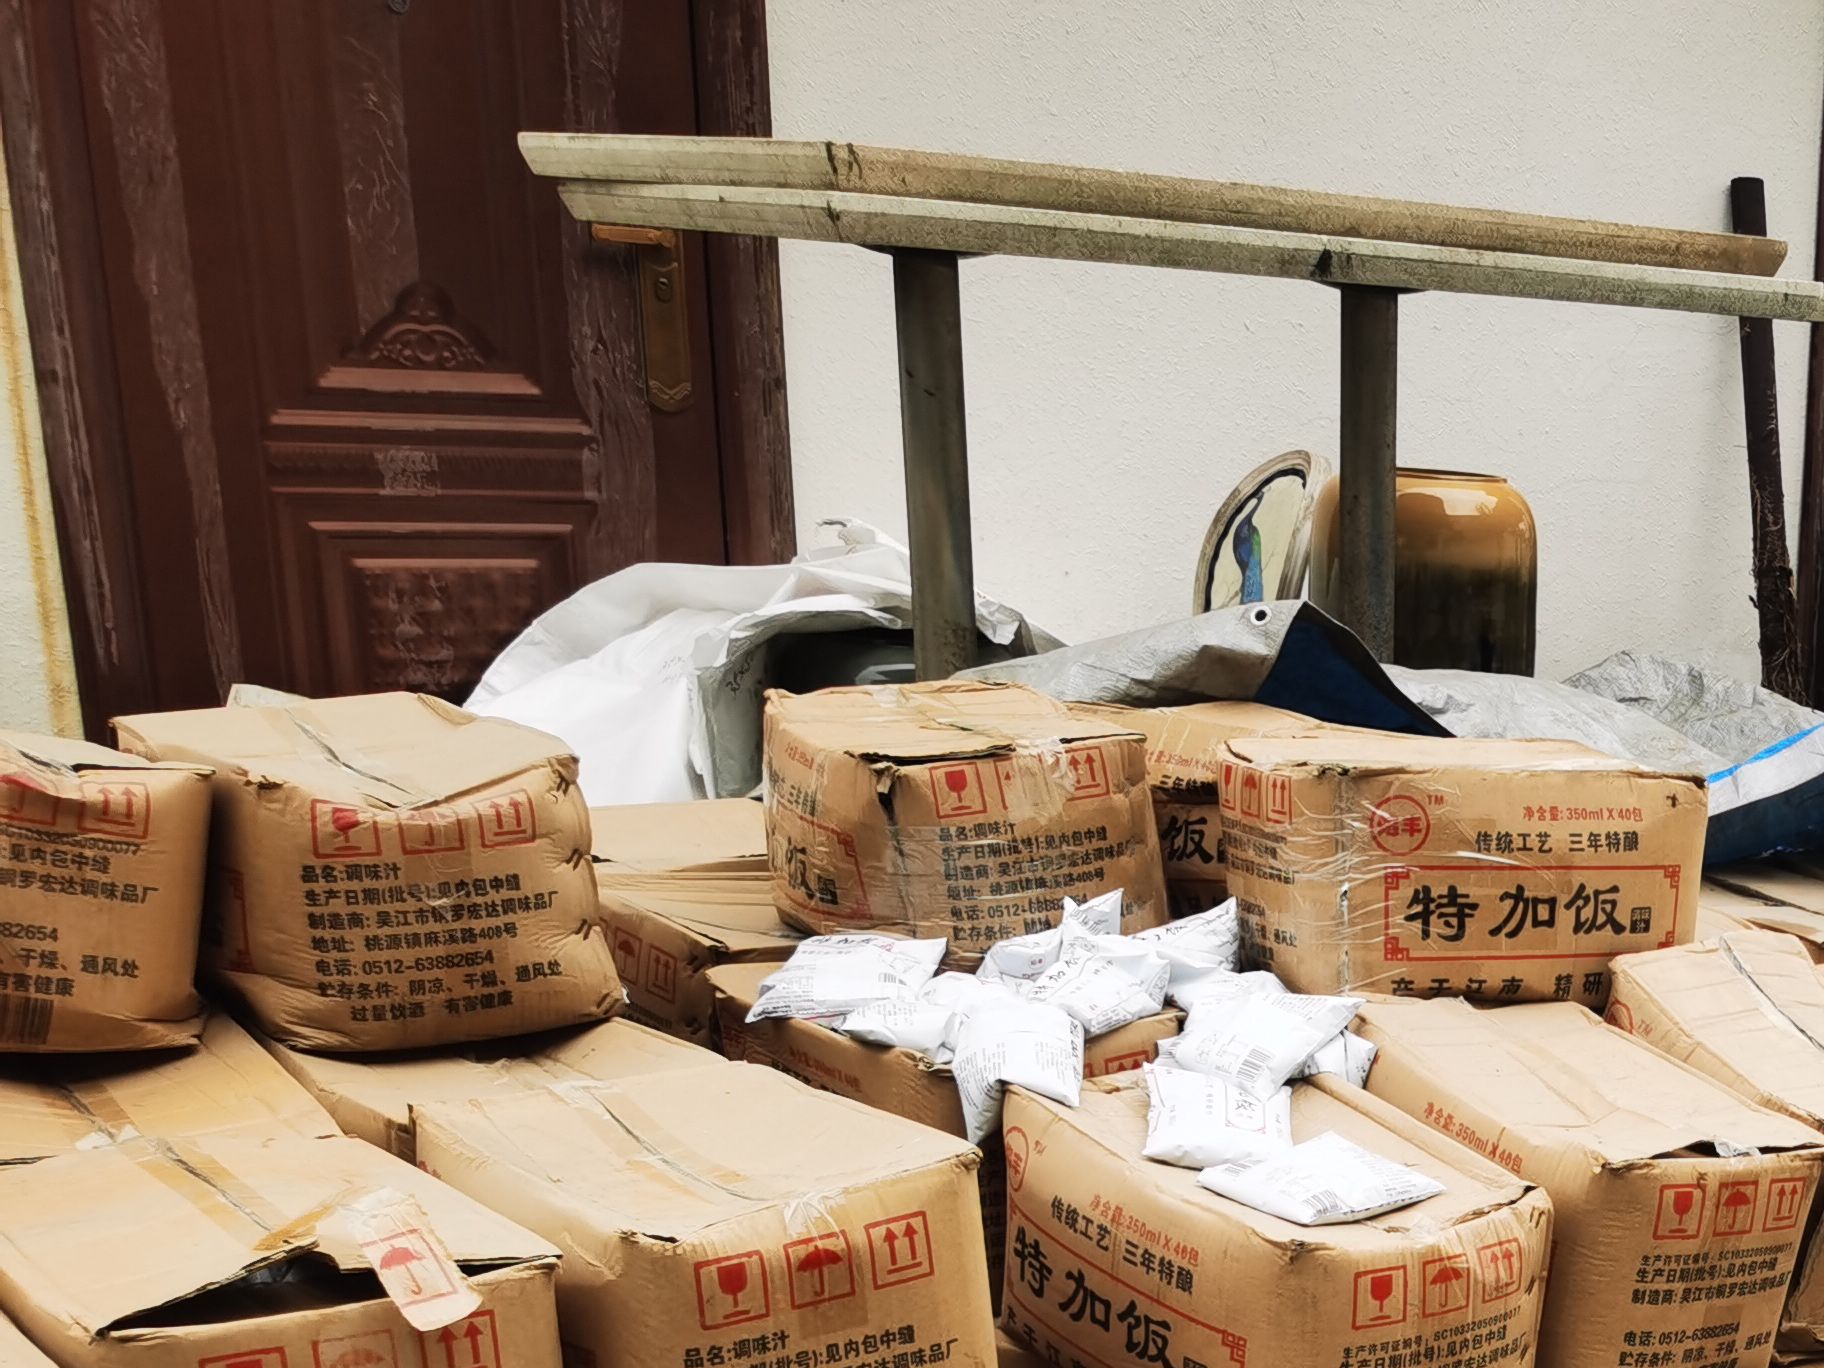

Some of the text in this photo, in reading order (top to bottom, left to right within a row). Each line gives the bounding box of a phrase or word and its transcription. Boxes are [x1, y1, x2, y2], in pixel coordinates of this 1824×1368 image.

[1475, 830, 1639, 855] 传统工艺 三年特酿
[301, 862, 401, 883] 品名:调味汁
[1403, 884, 1628, 941] 特加饭
[350, 991, 514, 1022] 过量饮酒 有害健康
[1050, 1195, 1194, 1296] 传统工艺 三年特酿
[684, 1330, 790, 1368] 品名:调味汁
